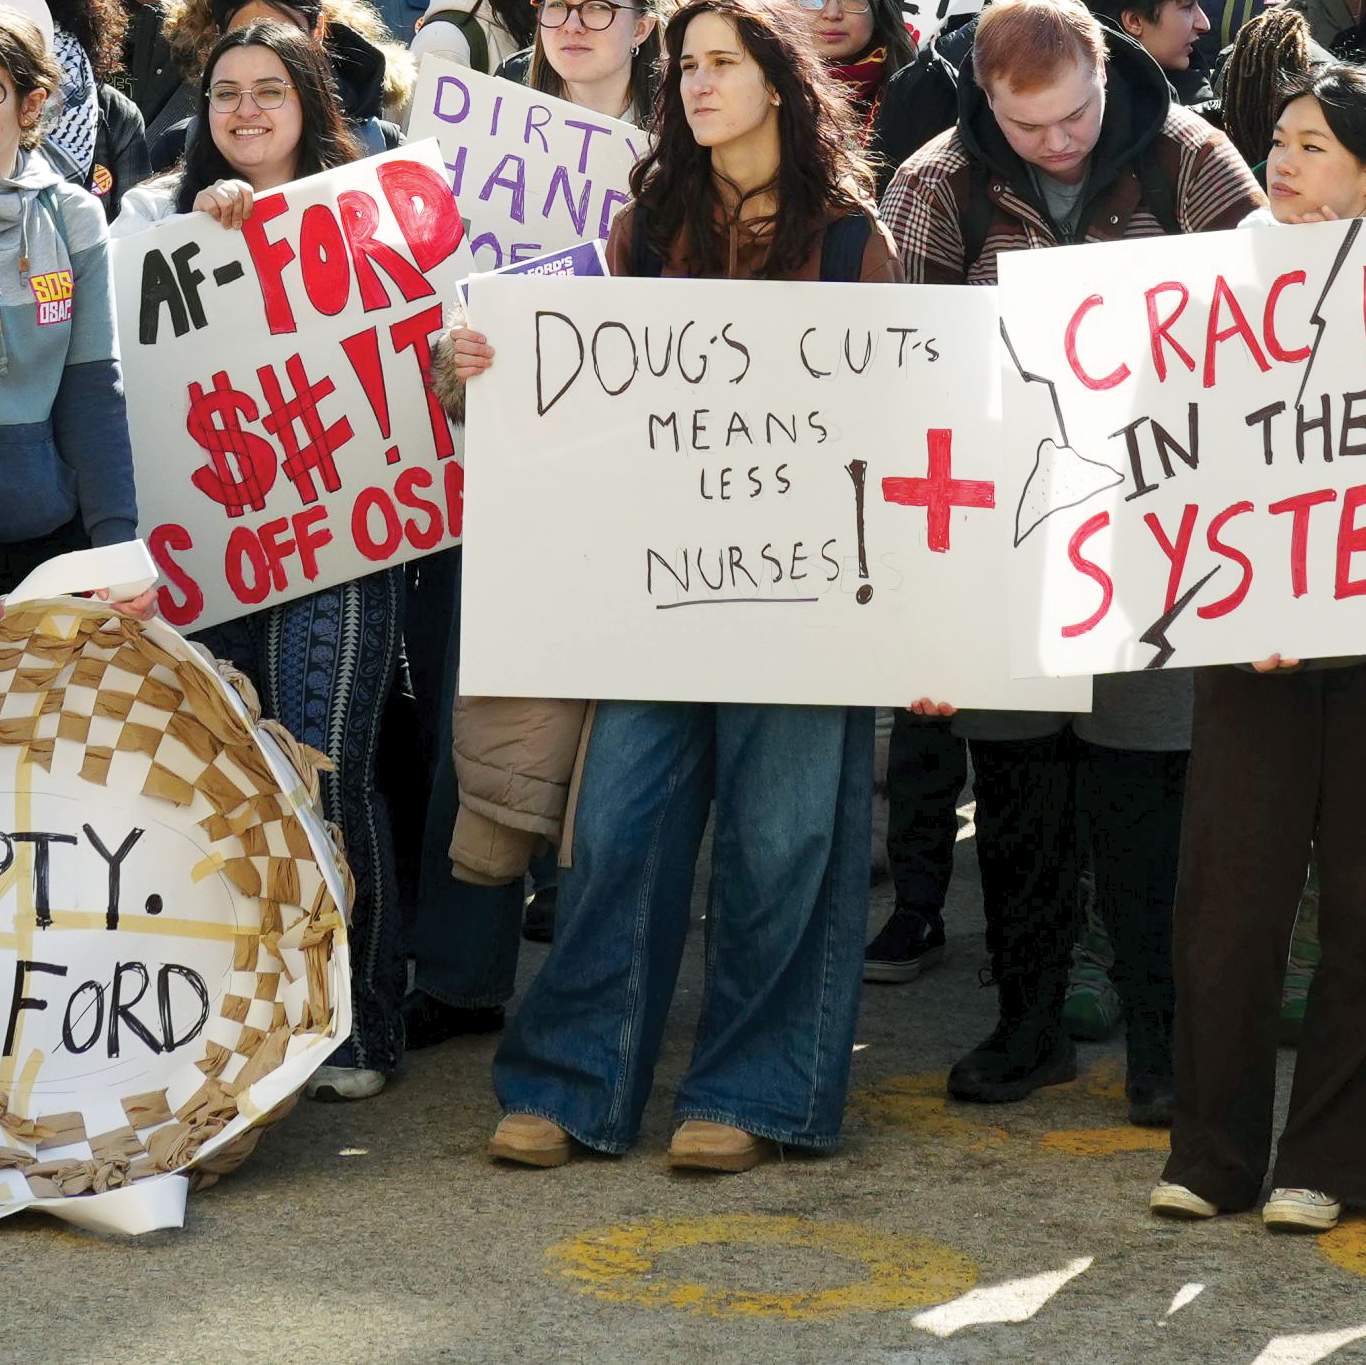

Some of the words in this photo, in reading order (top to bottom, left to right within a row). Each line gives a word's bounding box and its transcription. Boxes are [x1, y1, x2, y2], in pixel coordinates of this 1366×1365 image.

[30, 271, 74, 303] SOS
[140, 160, 466, 345] AF-FORD
[647, 408, 828, 452] MEANS
[1107, 403, 1199, 501] IN
[699, 463, 791, 502] LESS
[225, 504, 334, 604] OFF
[2, 960, 210, 1059] FORD
